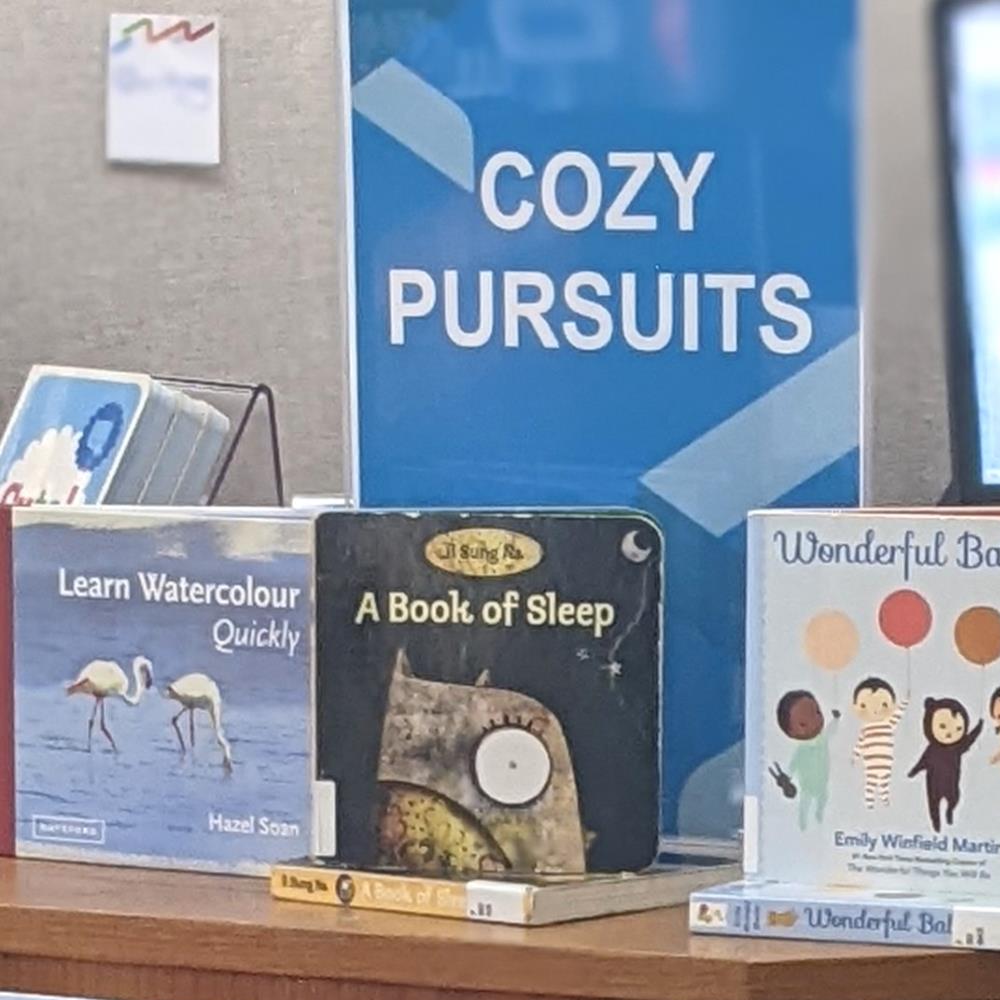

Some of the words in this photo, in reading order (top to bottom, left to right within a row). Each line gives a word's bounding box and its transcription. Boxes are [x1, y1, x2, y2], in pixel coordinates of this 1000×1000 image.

[480, 150, 715, 232] COZY
[388, 268, 813, 355] PURSUITS
[774, 530, 949, 582] Wonderful
[58, 567, 131, 599] Learn
[137, 571, 301, 610] Watercolour
[355, 591, 380, 624] A
[388, 590, 474, 625] Book
[482, 592, 521, 627] of
[527, 590, 616, 638] Sleep
[212, 618, 300, 656] Quickly
[207, 813, 255, 834] Hazel
[259, 818, 300, 837] Soan
[834, 831, 877, 852] Emily
[881, 834, 949, 853] Winfield
[804, 905, 912, 938] Wonderful
